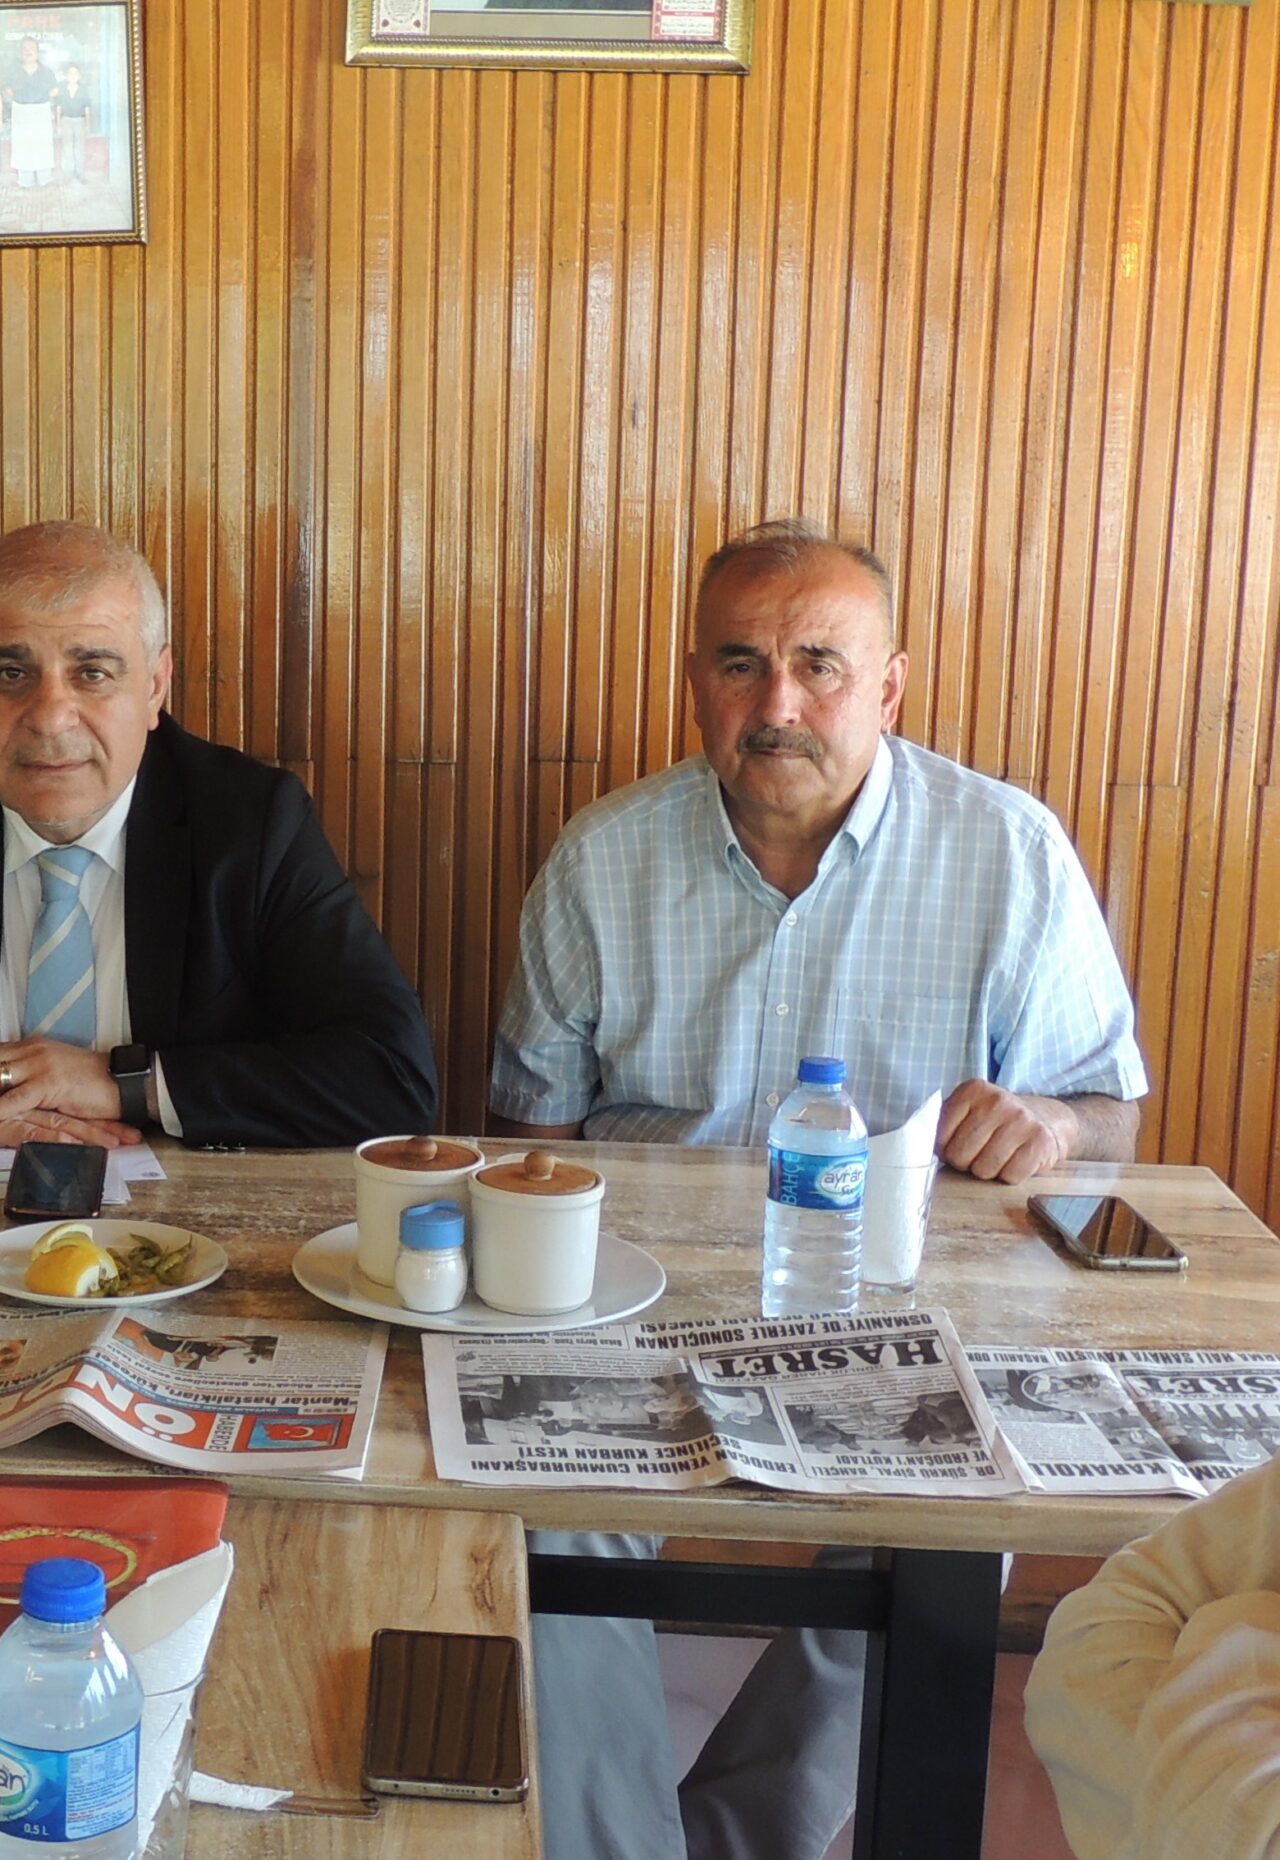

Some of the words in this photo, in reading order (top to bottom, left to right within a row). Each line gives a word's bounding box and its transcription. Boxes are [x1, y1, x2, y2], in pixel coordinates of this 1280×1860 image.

[822, 1314, 933, 1334] OSMANİYE'DE
[634, 1328, 745, 1350] SONUÇLANAN
[749, 1323, 816, 1341] ZAFERLE
[711, 1340, 944, 1378] HASRET
[1140, 1376, 1280, 1394] SRET
[517, 1446, 569, 1460] KESTİ
[574, 1447, 649, 1460] KURBAN
[835, 1454, 893, 1466] KUTLADI
[972, 1450, 990, 1462] VE
[470, 1459, 631, 1474] CUMHURBAŞKANI
[637, 1455, 711, 1476] YENİDEN
[970, 1465, 996, 1477] DR.
[919, 1466, 968, 1480] ŞÜKRÜ
[24, 1823, 39, 1835] 0.5
